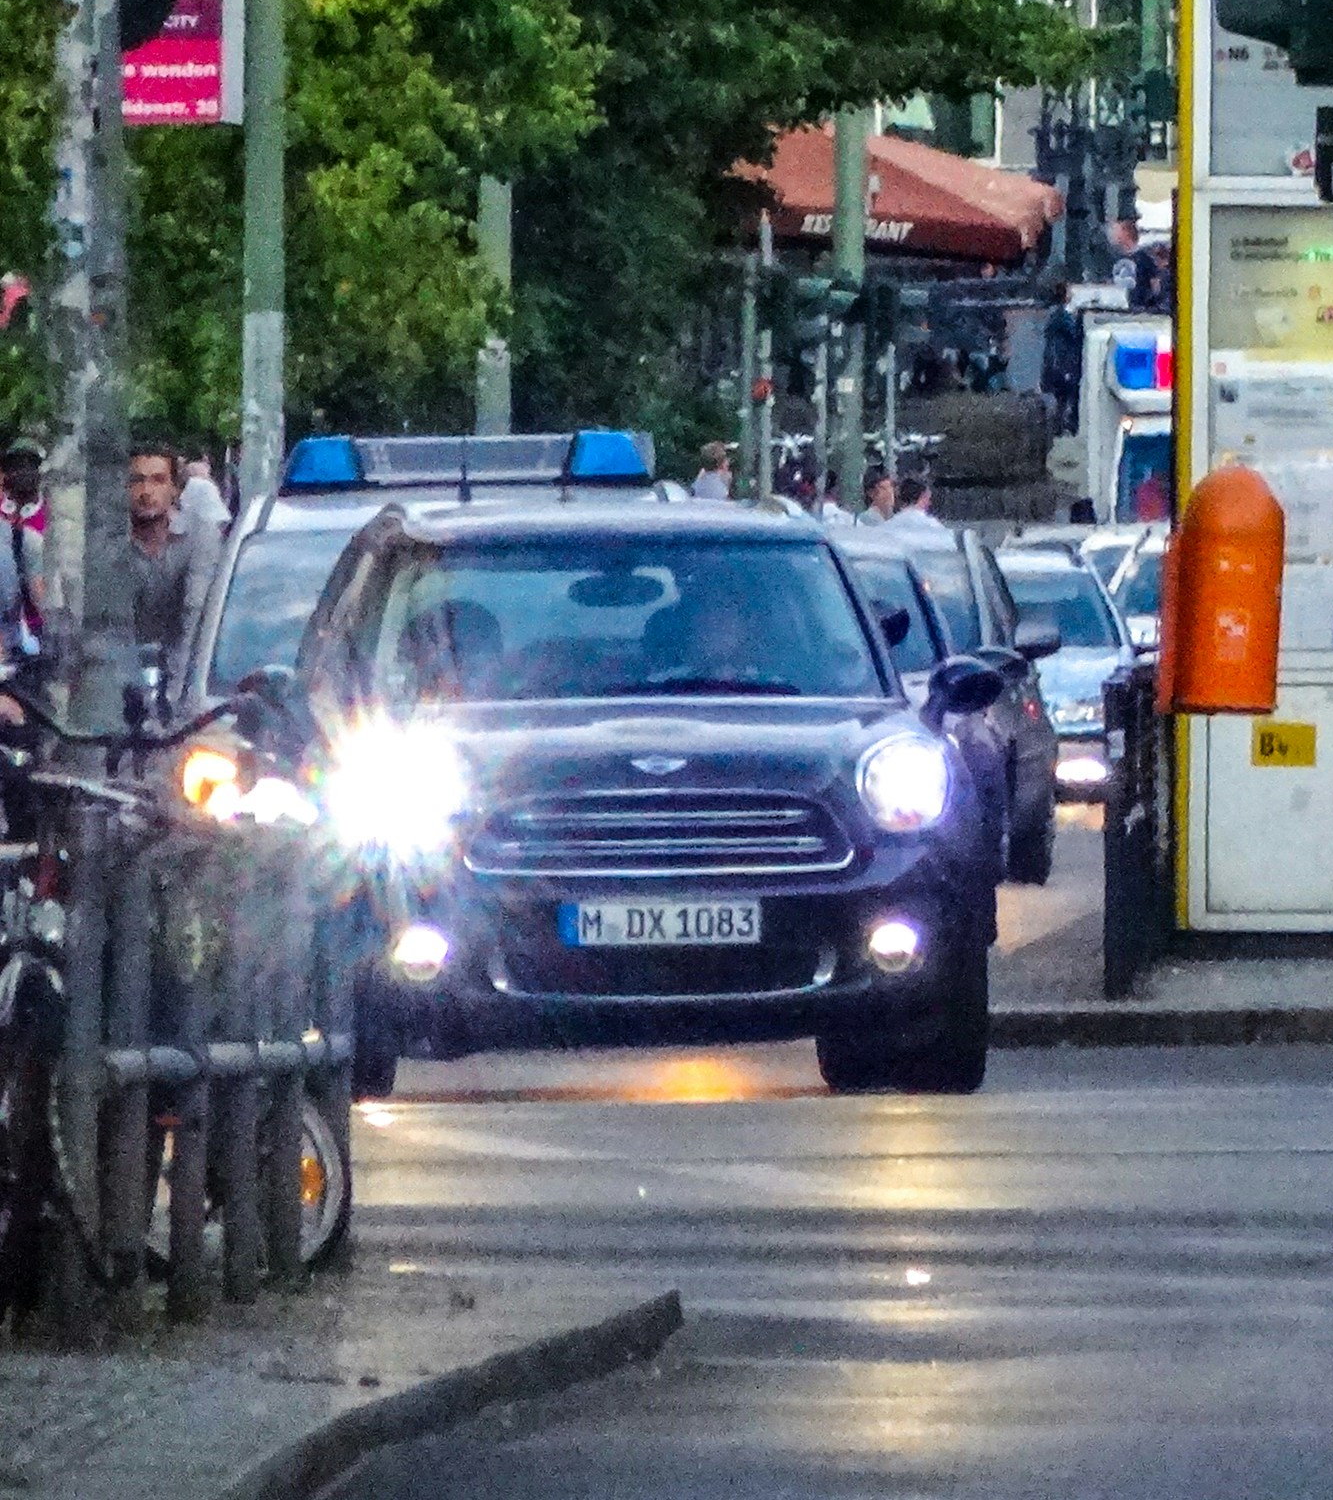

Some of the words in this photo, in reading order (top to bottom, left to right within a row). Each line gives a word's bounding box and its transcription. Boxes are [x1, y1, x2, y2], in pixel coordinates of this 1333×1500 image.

[581, 908, 603, 939] M
[626, 908, 667, 940] DX
[676, 907, 755, 939] 1083
